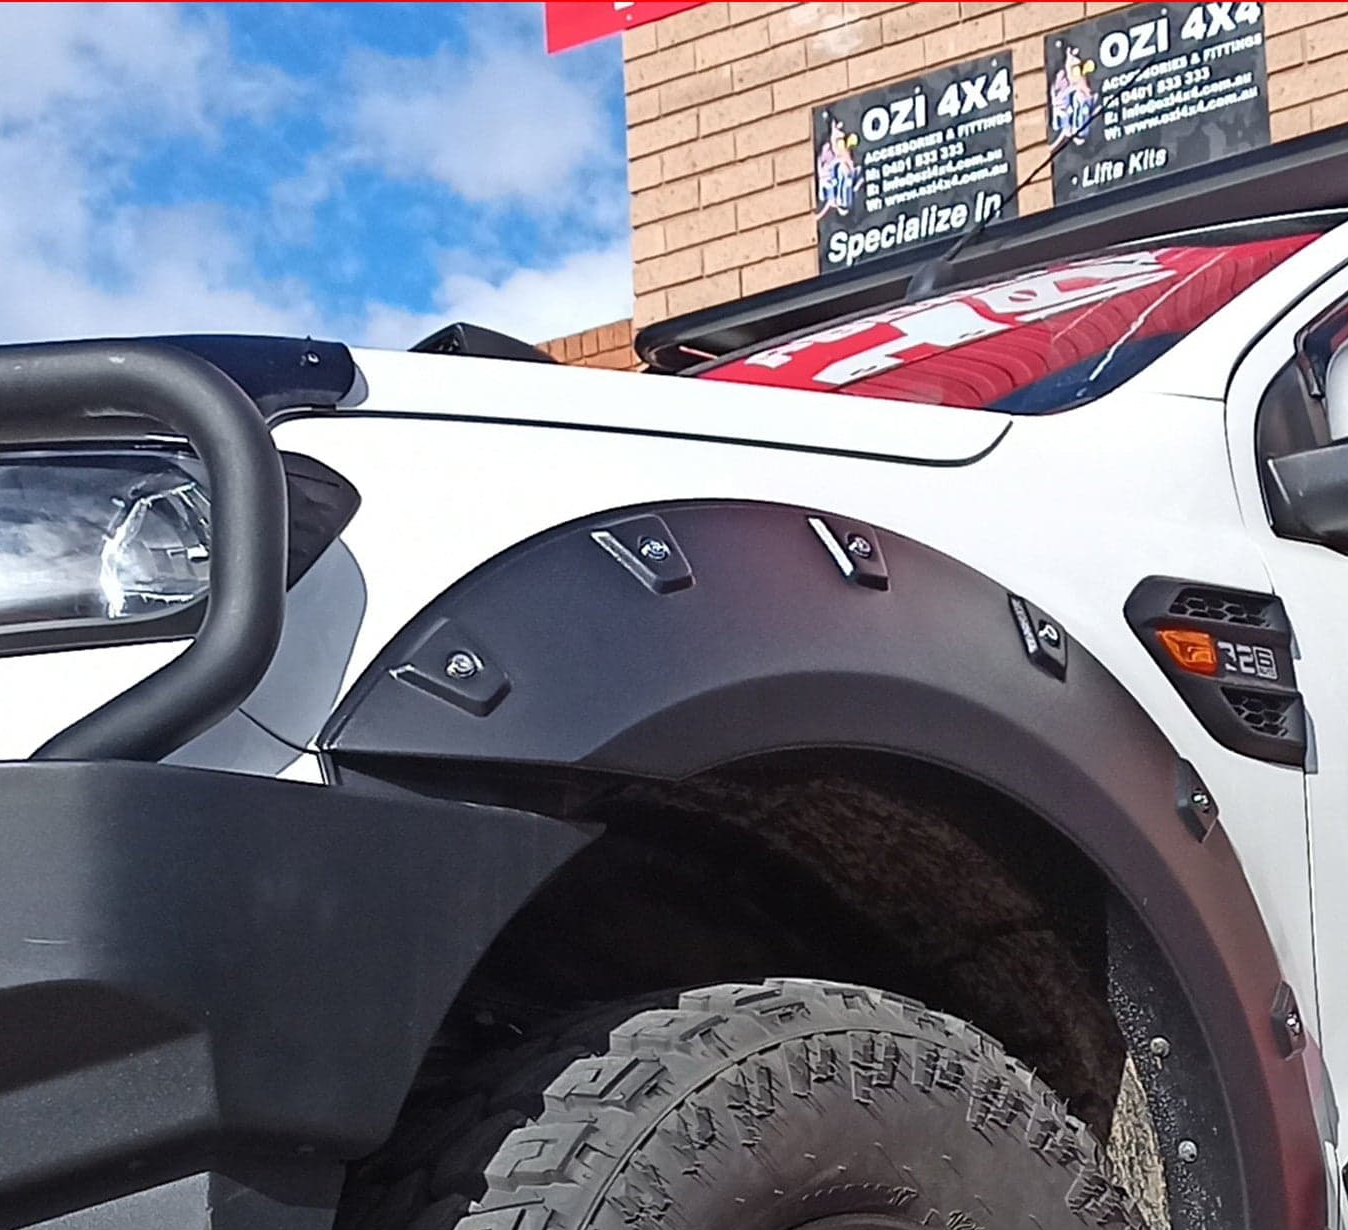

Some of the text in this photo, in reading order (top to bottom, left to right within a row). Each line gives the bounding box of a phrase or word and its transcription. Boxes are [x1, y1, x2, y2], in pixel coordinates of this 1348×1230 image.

[1203, 32, 1263, 63] FITTINGS
[1120, 83, 1153, 105] 0401
[1184, 66, 1211, 85] 333
[1128, 147, 1166, 176] Kits
[827, 204, 968, 267] Specialize
